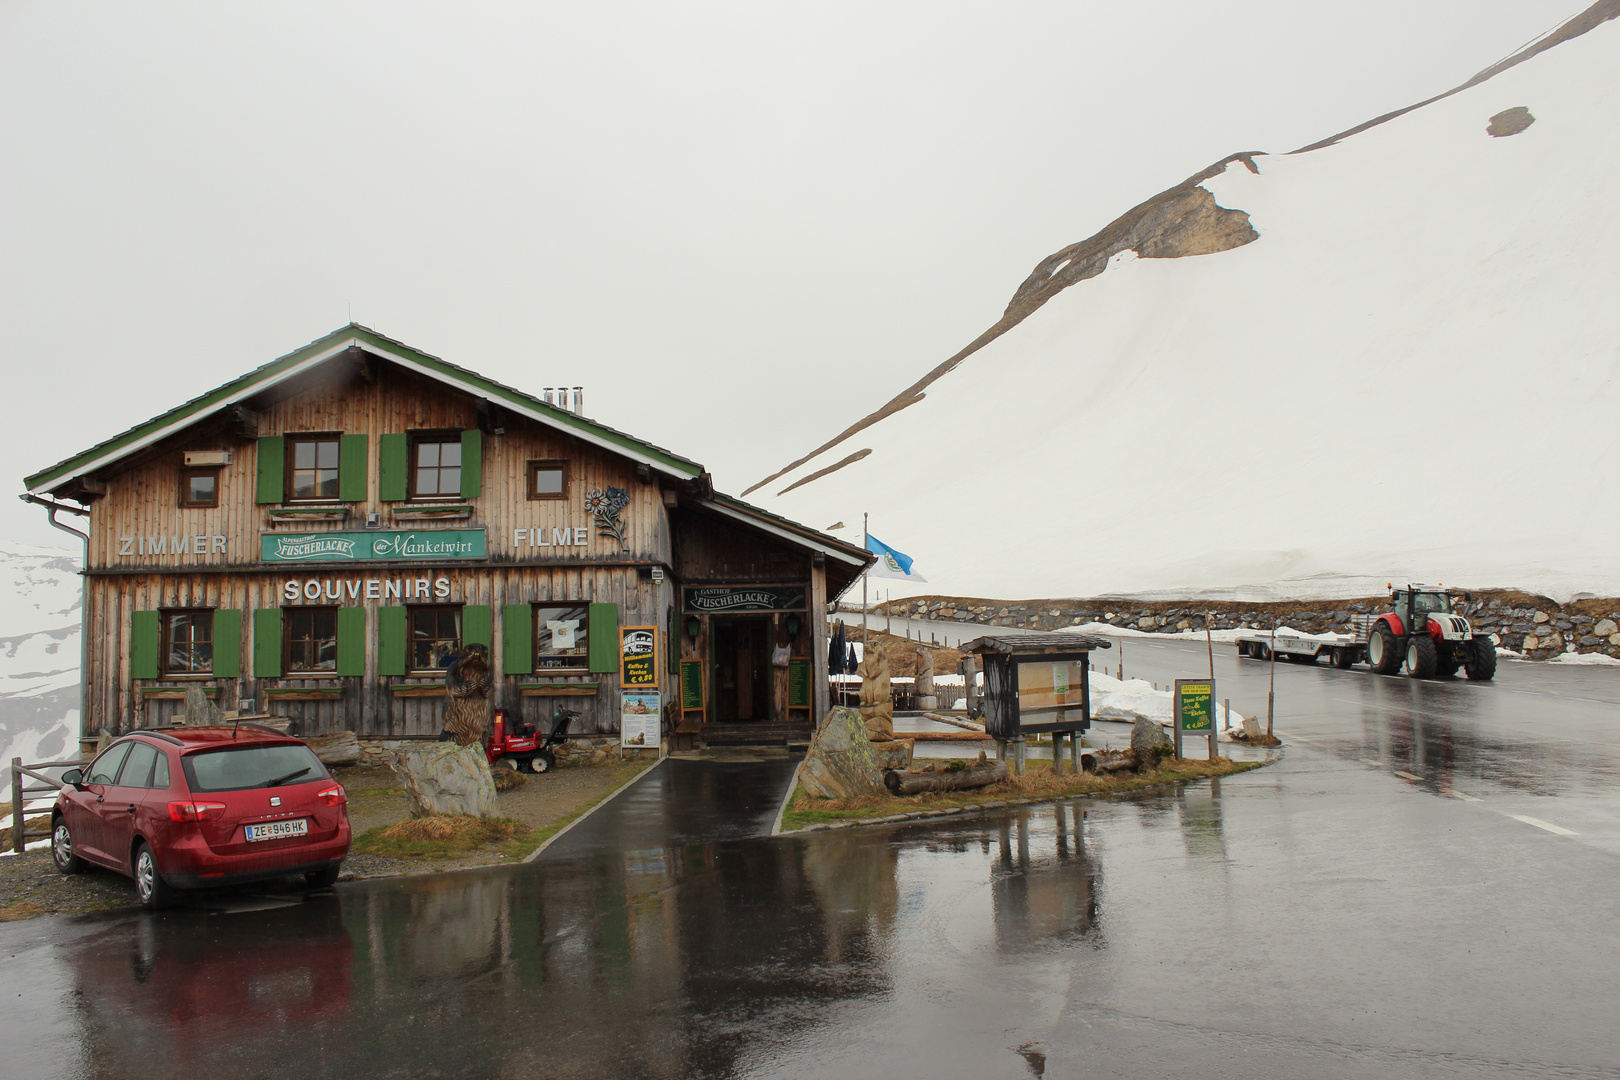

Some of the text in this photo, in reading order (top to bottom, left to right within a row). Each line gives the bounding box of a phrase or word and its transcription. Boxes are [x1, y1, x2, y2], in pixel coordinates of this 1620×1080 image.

[119, 534, 227, 556] ZIMMER
[280, 540, 350, 556] FUSCHERLACKE
[392, 534, 473, 556] Mankeiwirt
[514, 527, 588, 548] FILME
[284, 577, 451, 600] SOUVENIRS
[697, 592, 770, 608] FUSCHERLACKE
[254, 826, 266, 837] ZE
[273, 823, 290, 834] 946
[292, 822, 304, 832] HK
